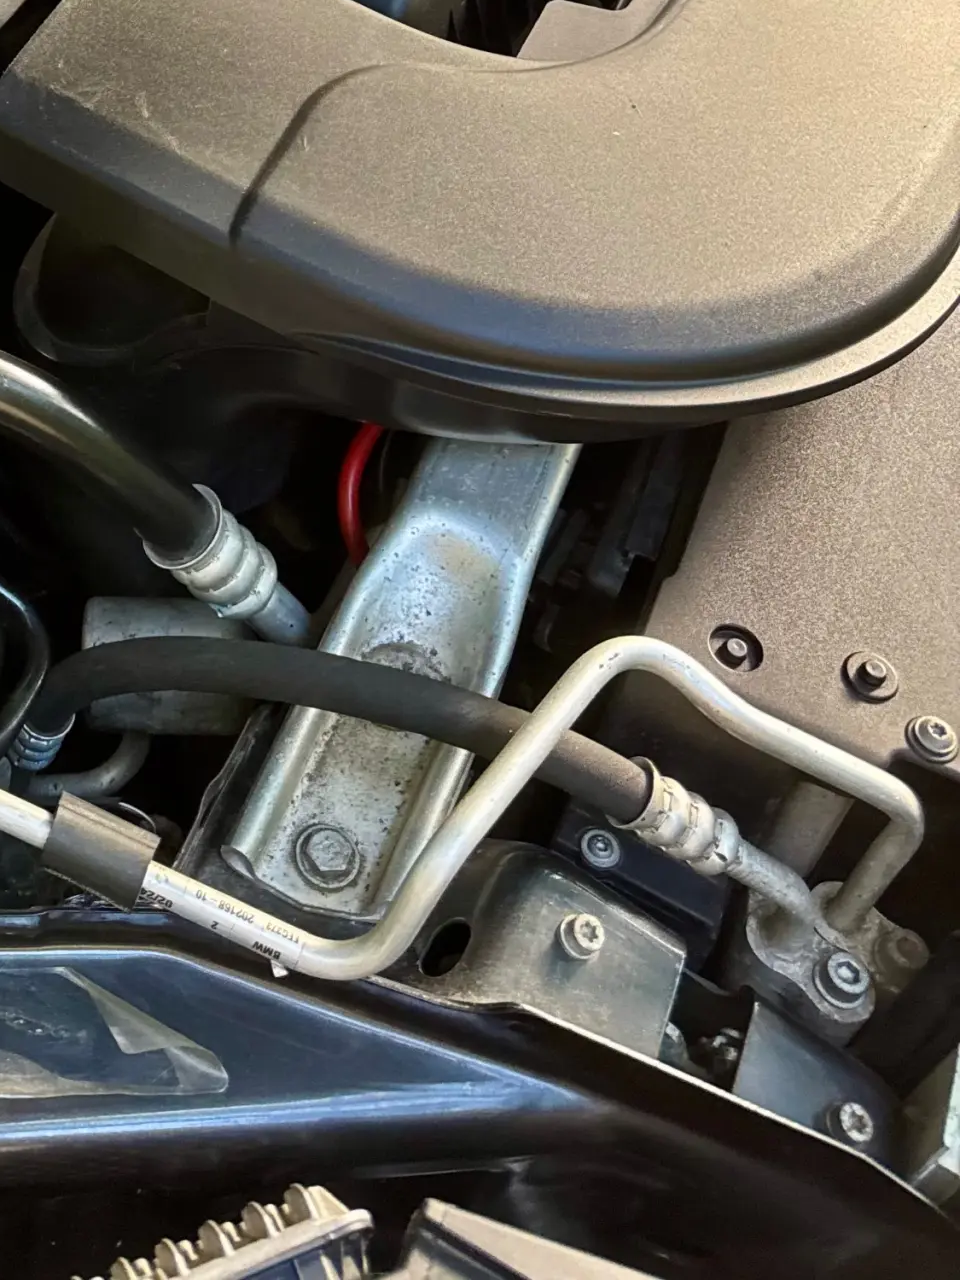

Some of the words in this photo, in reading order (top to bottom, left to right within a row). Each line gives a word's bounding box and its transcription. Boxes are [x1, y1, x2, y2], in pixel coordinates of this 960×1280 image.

[141, 887, 174, 909] 02/24
[210, 920, 220, 931] 2
[252, 940, 282, 961] BMW
